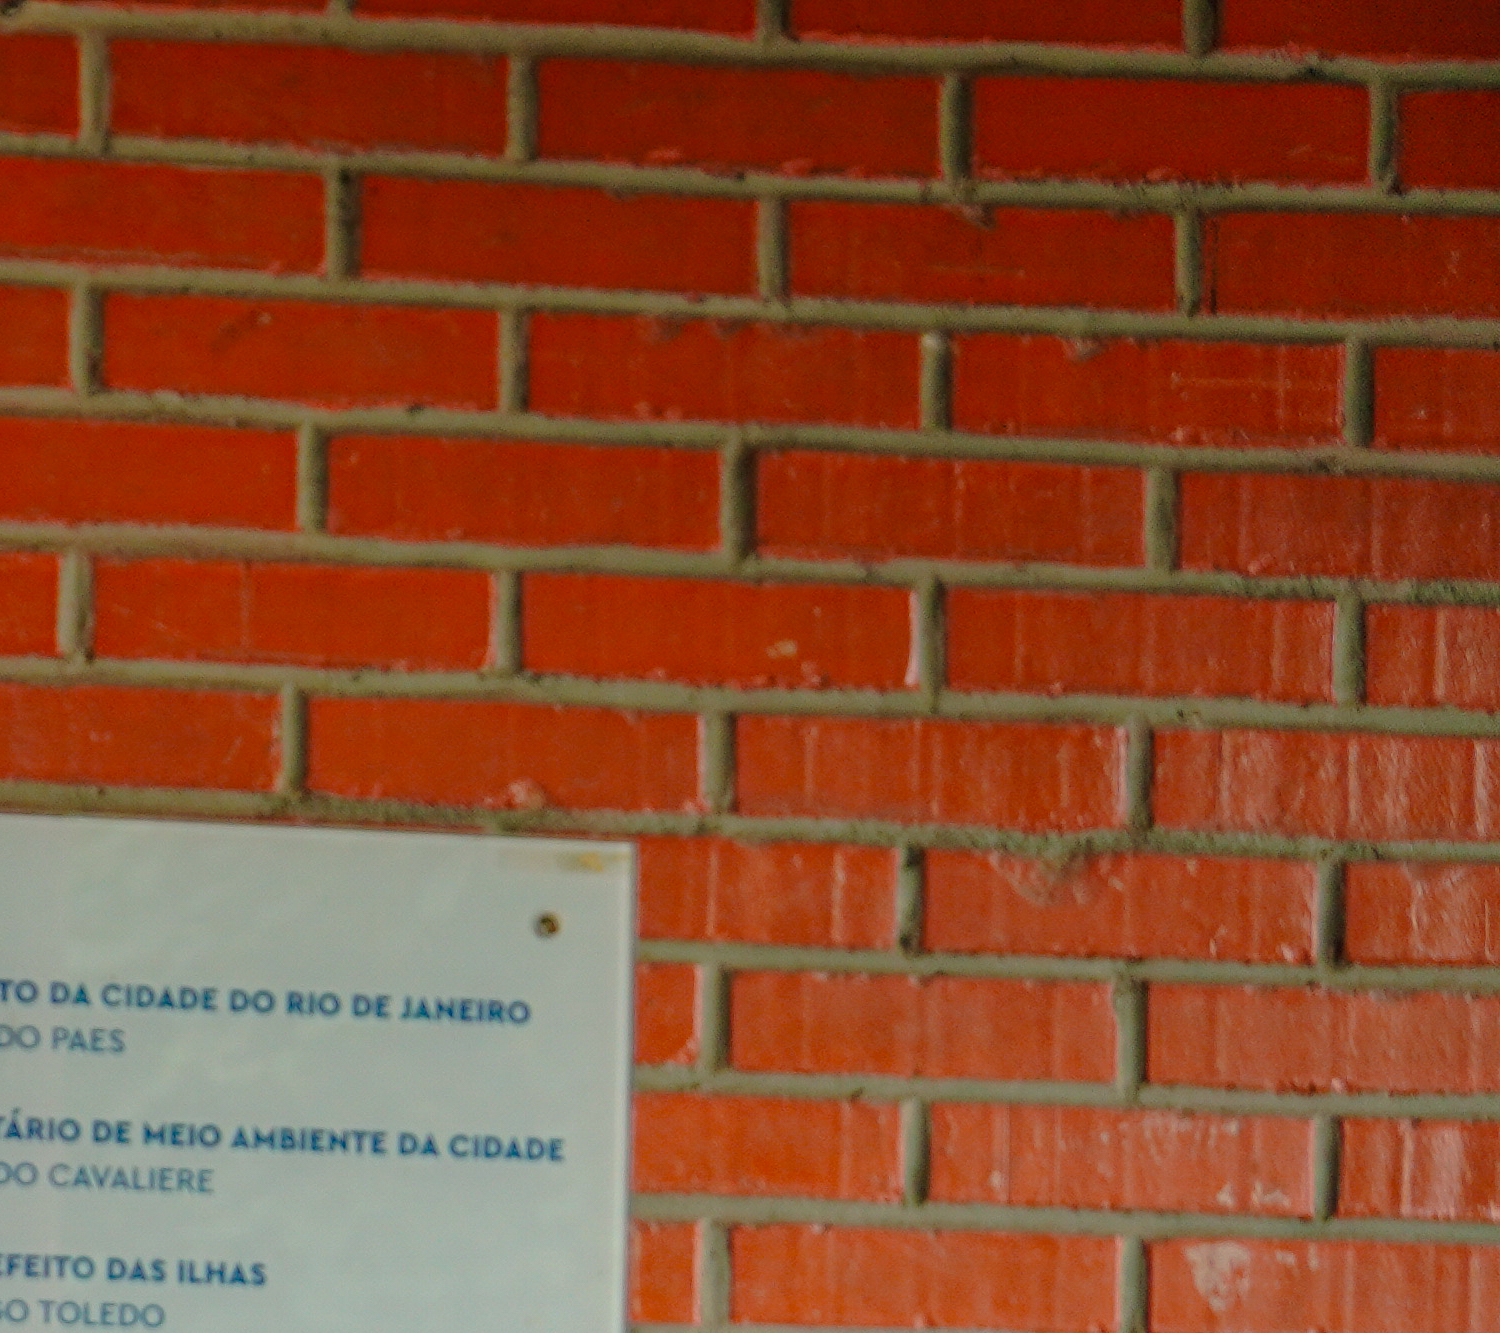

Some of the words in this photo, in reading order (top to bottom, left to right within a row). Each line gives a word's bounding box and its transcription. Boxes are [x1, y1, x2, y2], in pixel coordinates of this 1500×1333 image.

[49, 980, 92, 1008] DA
[100, 982, 219, 1014] CIDADE
[228, 987, 277, 1016] DO
[285, 990, 342, 1018] RIO
[351, 992, 392, 1020] DE
[400, 995, 532, 1027] JANEIRO
[50, 1024, 127, 1056] PAES
[91, 1118, 132, 1147] DE
[142, 1121, 223, 1150] MEIO
[230, 1125, 388, 1158] AMBIENTE
[397, 1131, 441, 1159] DA
[447, 1133, 565, 1164] CIDADE
[47, 1161, 215, 1197] CAVALIERE
[106, 1256, 167, 1284] DAS
[177, 1258, 268, 1288] ILHAS
[37, 1298, 167, 1331] TOLEDO
